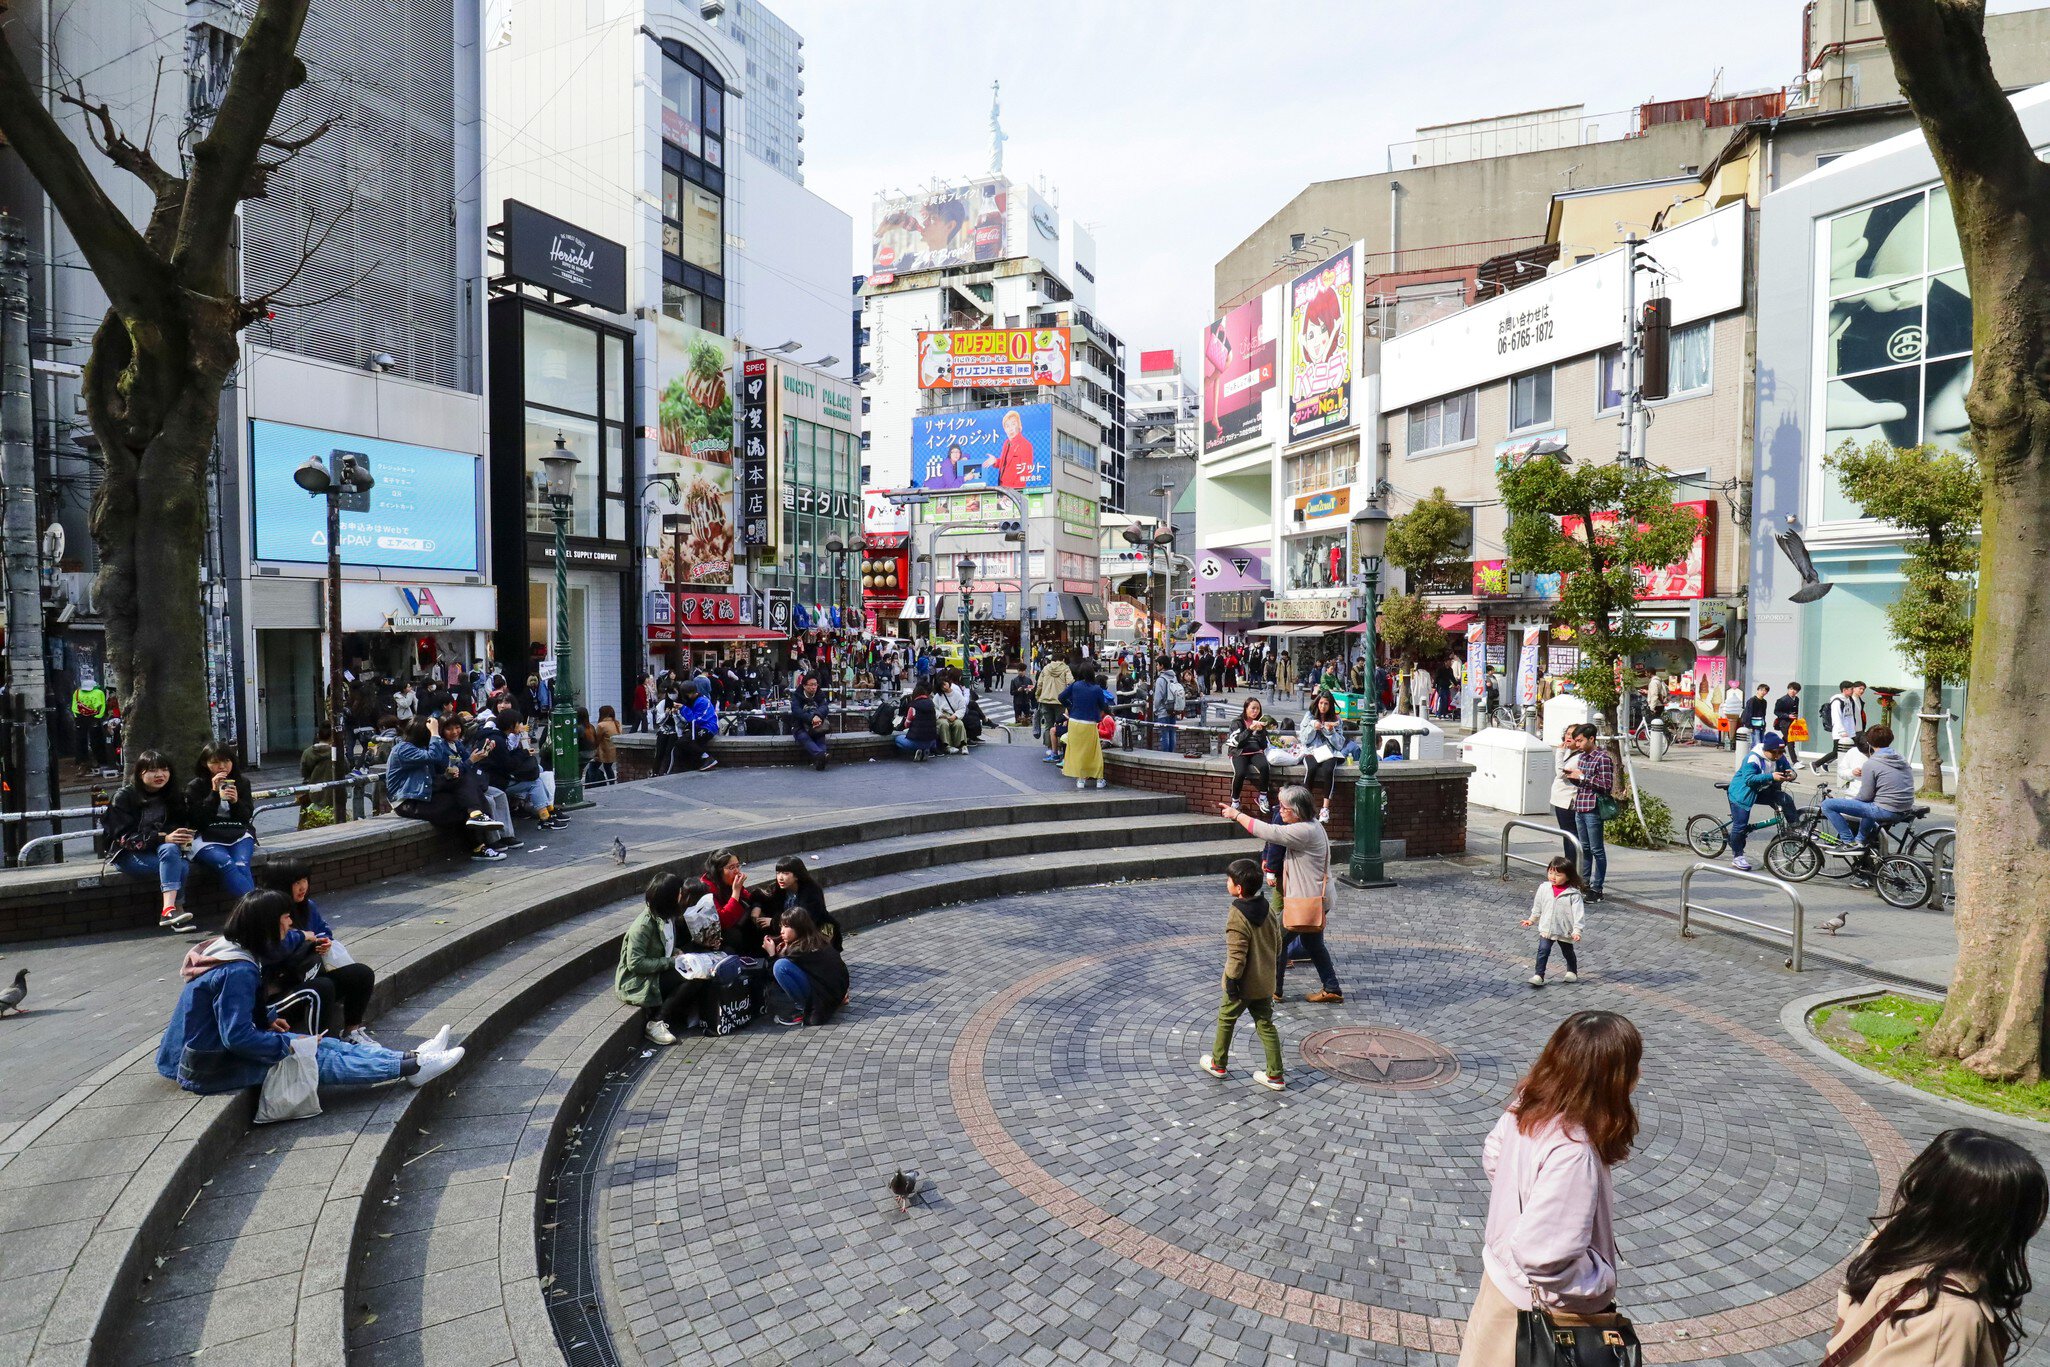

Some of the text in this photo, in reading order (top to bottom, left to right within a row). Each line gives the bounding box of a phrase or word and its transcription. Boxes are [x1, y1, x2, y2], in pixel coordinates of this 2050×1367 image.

[549, 235, 594, 270] Herschel
[1498, 303, 1549, 335] お問い合わせは
[1497, 319, 1554, 356] 06-6765-1872
[746, 364, 765, 372] SPEC
[956, 366, 1013, 375] オリエント住宅
[925, 418, 977, 434] リサイクル
[747, 378, 765, 513] 甲賀流本店
[926, 429, 1000, 449] インクのジット
[924, 455, 943, 481] jit
[1016, 462, 1046, 474] ジット
[783, 484, 860, 517] 電子タバコ
[544, 548, 618, 561] HEREL SUPPLY COMPANY
[1202, 560, 1218, 576] ふ
[682, 597, 734, 621] 甲賀流
[775, 606, 785, 620] 48
[655, 630, 672, 638] Coca-Cola
